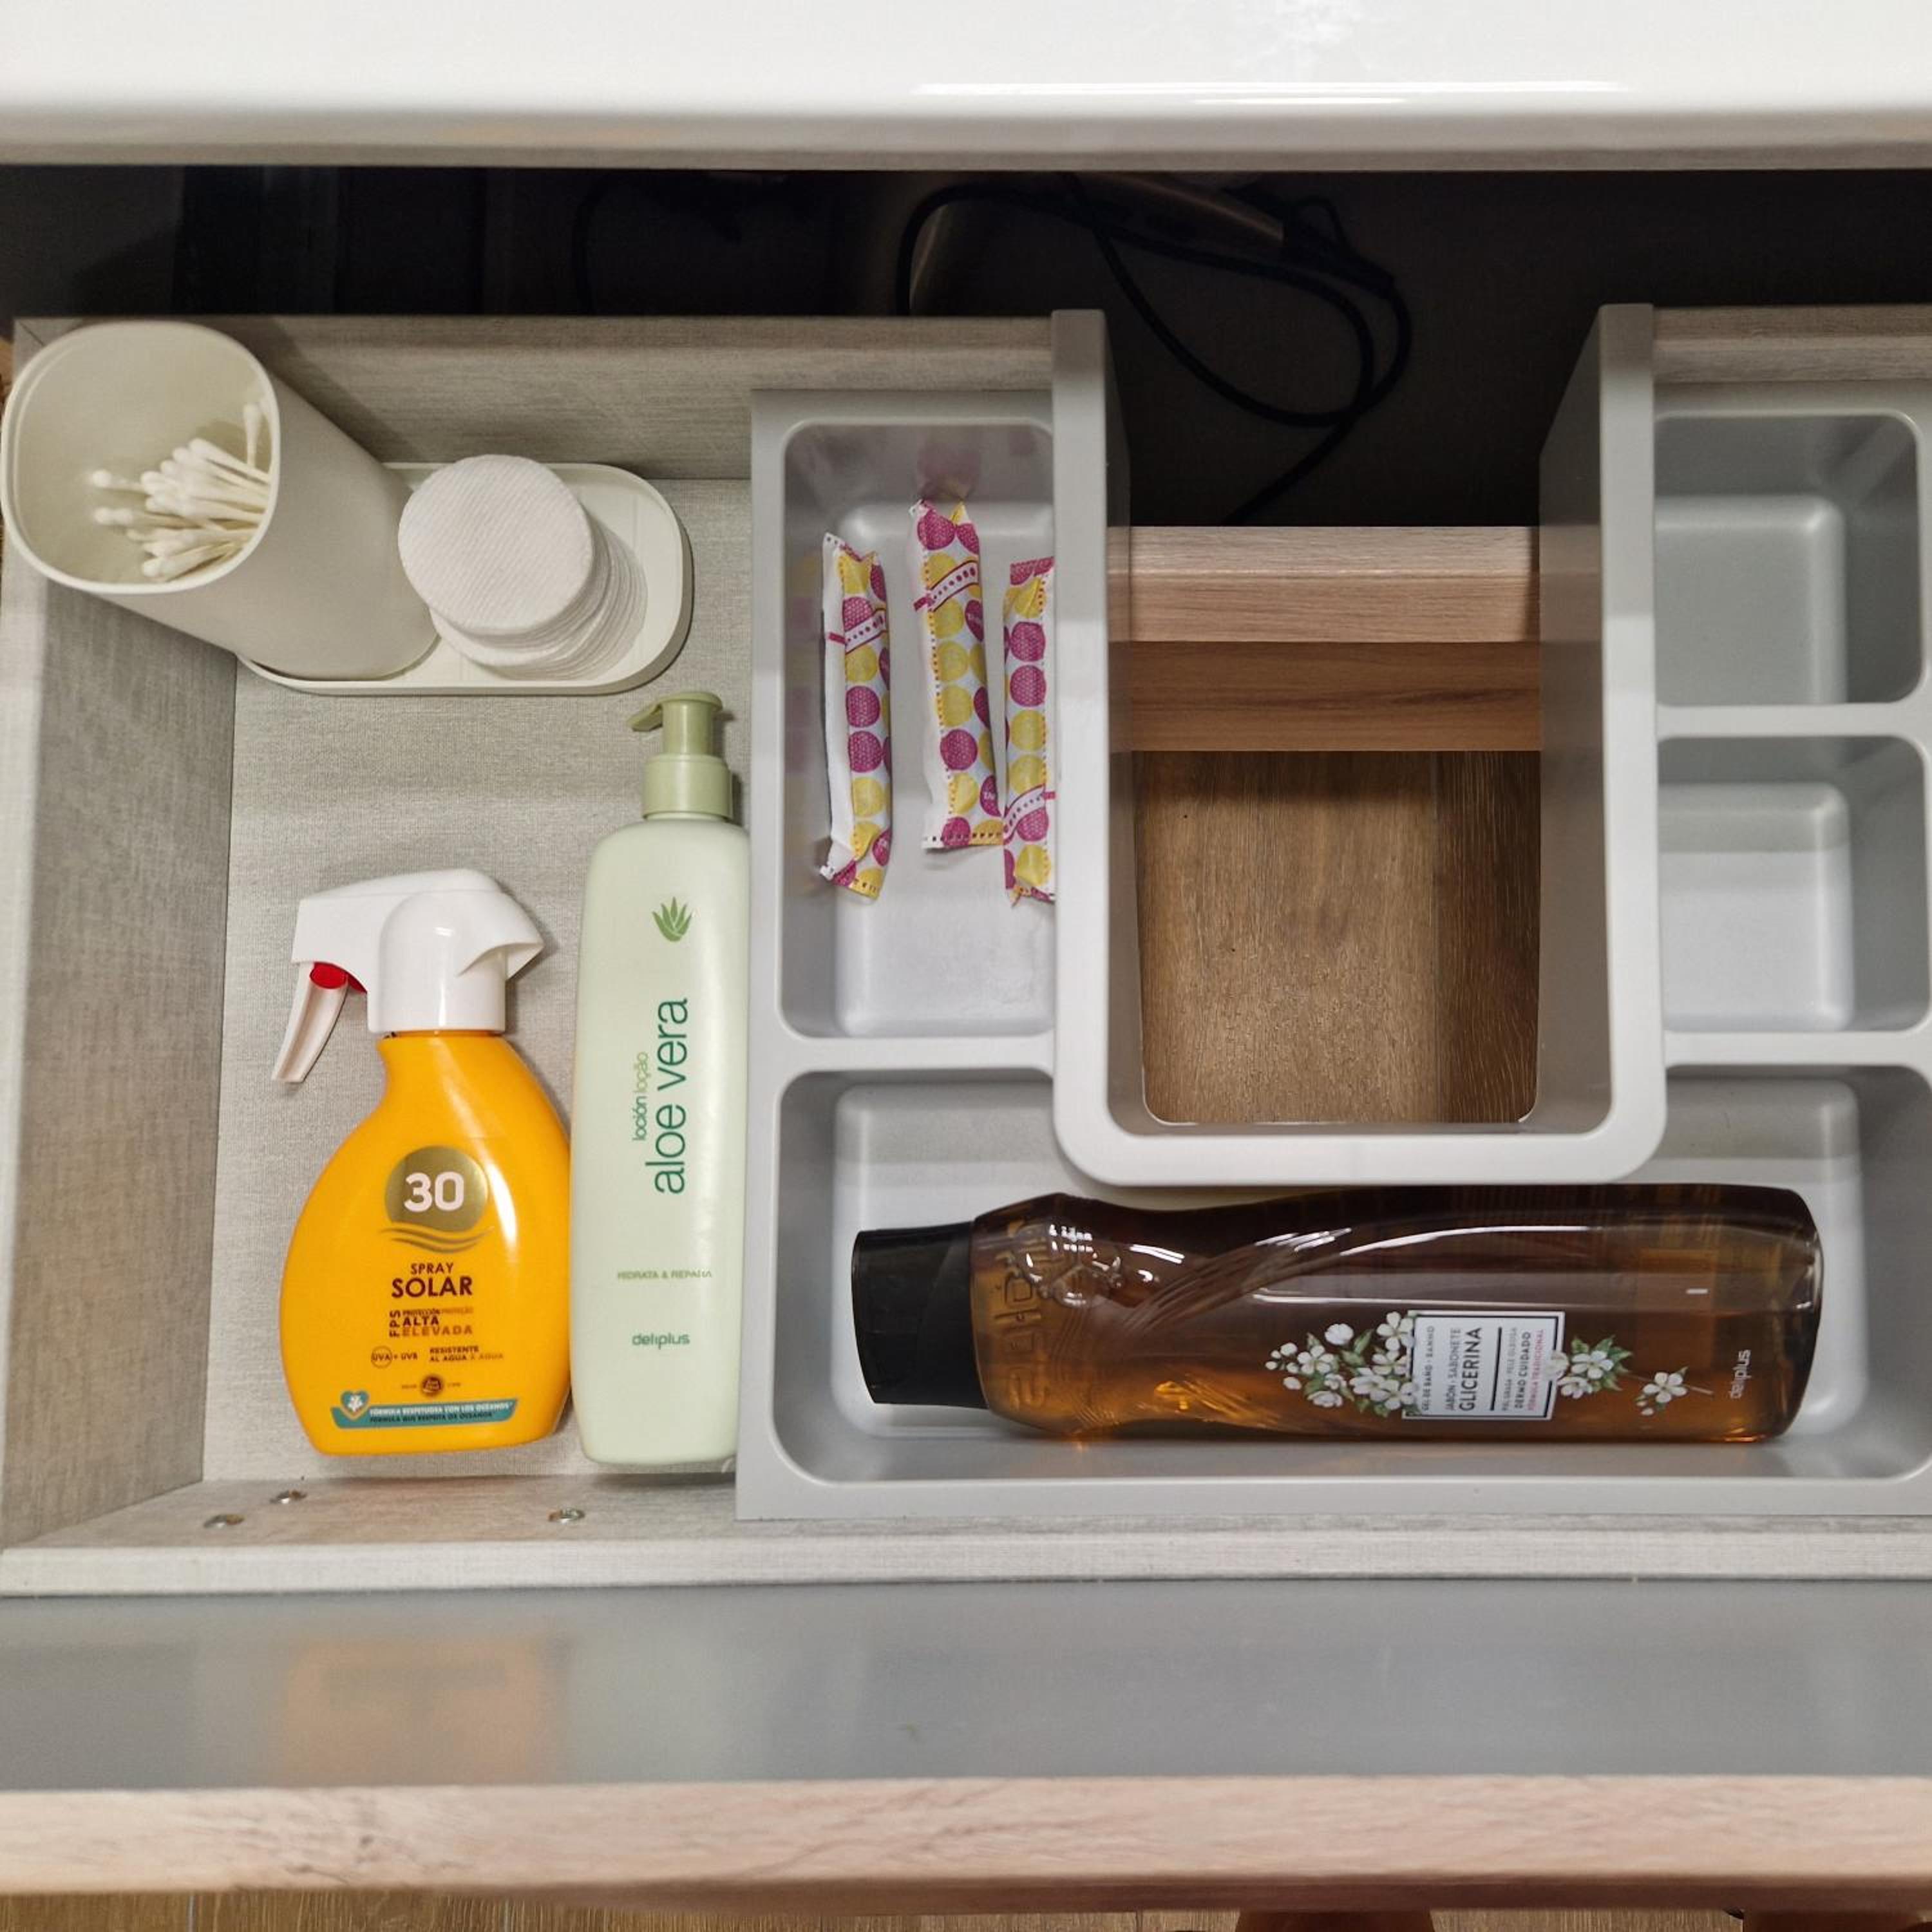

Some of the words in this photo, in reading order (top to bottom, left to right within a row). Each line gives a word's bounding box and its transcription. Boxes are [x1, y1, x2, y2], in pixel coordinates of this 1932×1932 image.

[657, 998, 688, 1092] vera
[633, 1052, 650, 1093] loção
[632, 1096, 647, 1141] loción
[645, 1104, 686, 1194] aloe
[403, 1171, 464, 1212] 30
[391, 1276, 473, 1298] SOLAR
[411, 1262, 454, 1275] SPRAY
[618, 1270, 659, 1280] HIDRATA
[402, 1316, 439, 1326] ALTA
[402, 1325, 473, 1336] ELEVADA
[632, 1332, 690, 1350] deliplus
[373, 1353, 390, 1361] UVA
[430, 1345, 478, 1354] RESISTENTE
[1447, 1329, 1461, 1378] SABONETE
[1459, 1327, 1481, 1411] GLICERINA
[1518, 1332, 1531, 1377] CUIDADO
[1531, 1329, 1543, 1380] TRADICIONAL
[1514, 1379, 1526, 1408] DERMO
[1729, 1349, 1751, 1399] deliplus
